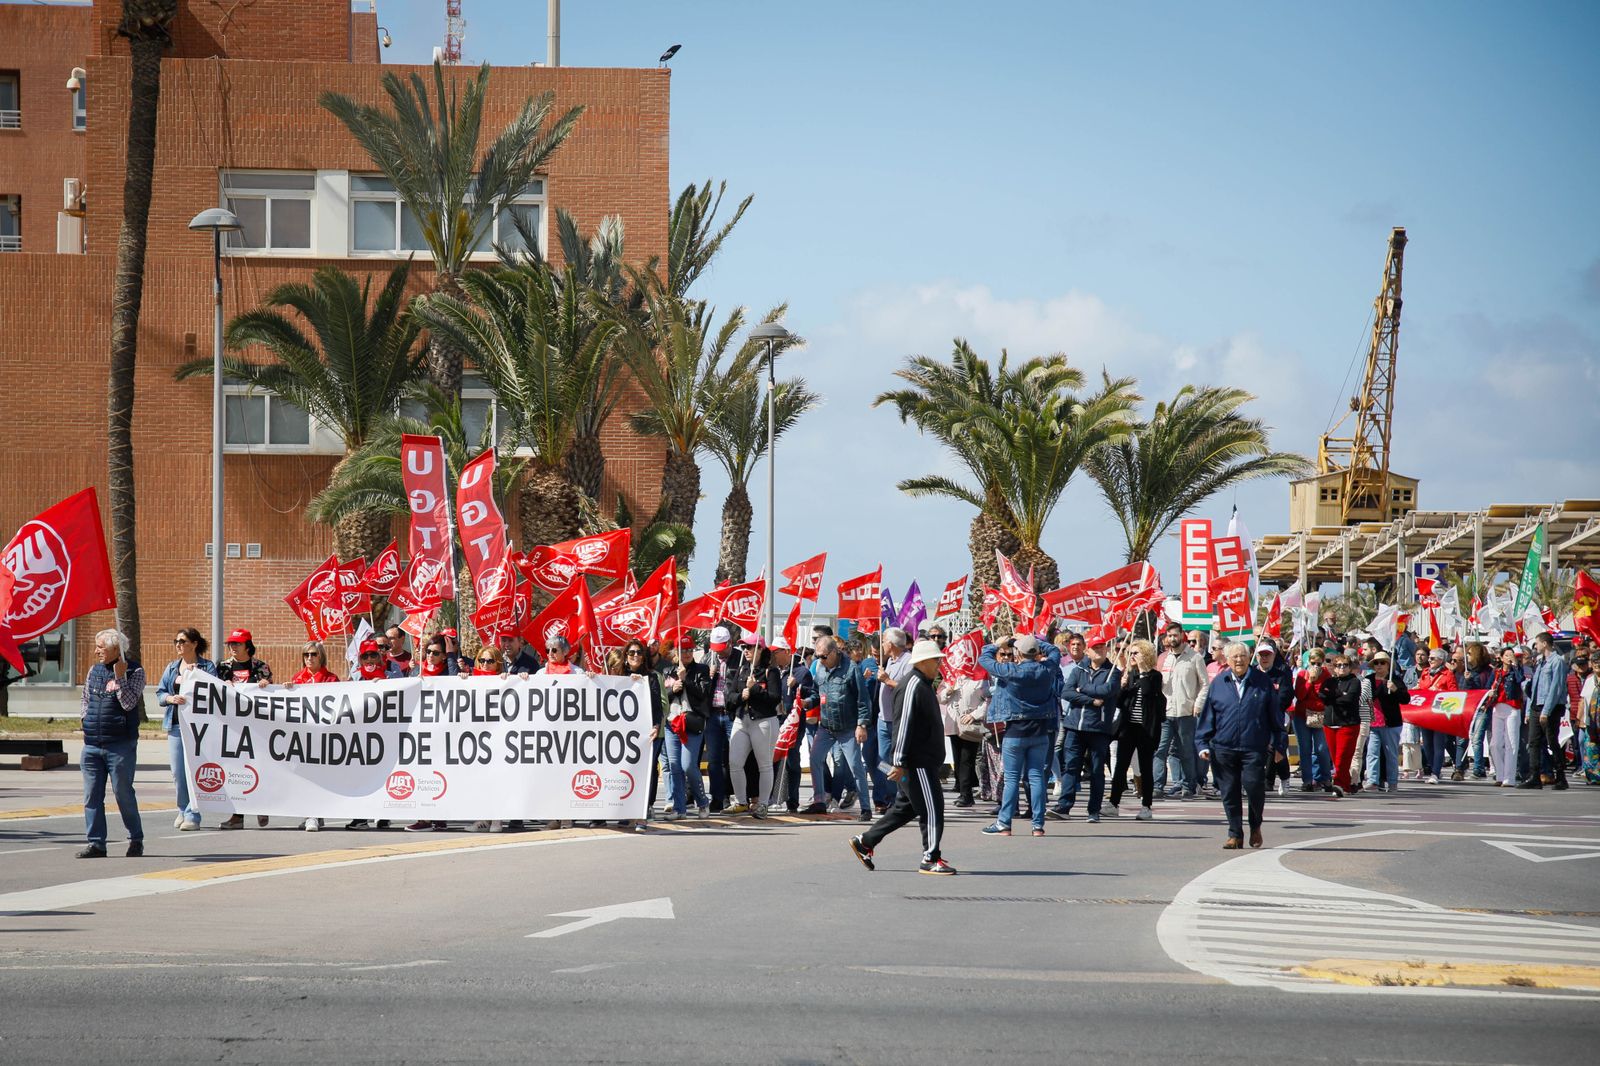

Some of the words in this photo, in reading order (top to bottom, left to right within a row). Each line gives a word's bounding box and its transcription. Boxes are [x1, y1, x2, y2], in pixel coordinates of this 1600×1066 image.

[1186, 524, 1208, 611] CCOO
[192, 681, 227, 716] EN
[235, 692, 355, 725] DEFENSA
[363, 690, 413, 724] DEL
[420, 689, 520, 723] EMPLEO
[528, 679, 639, 722] PÚBLICO
[190, 722, 209, 756] Y
[221, 724, 255, 760] LA
[268, 729, 385, 766] CALIDAD
[399, 732, 432, 765] DE
[445, 731, 492, 765] LOS
[504, 730, 641, 765] SERVICIOS
[199, 767, 222, 781] UGT
[228, 772, 253, 780] Servicios
[576, 774, 598, 788] UGT
[389, 775, 412, 789] UGT
